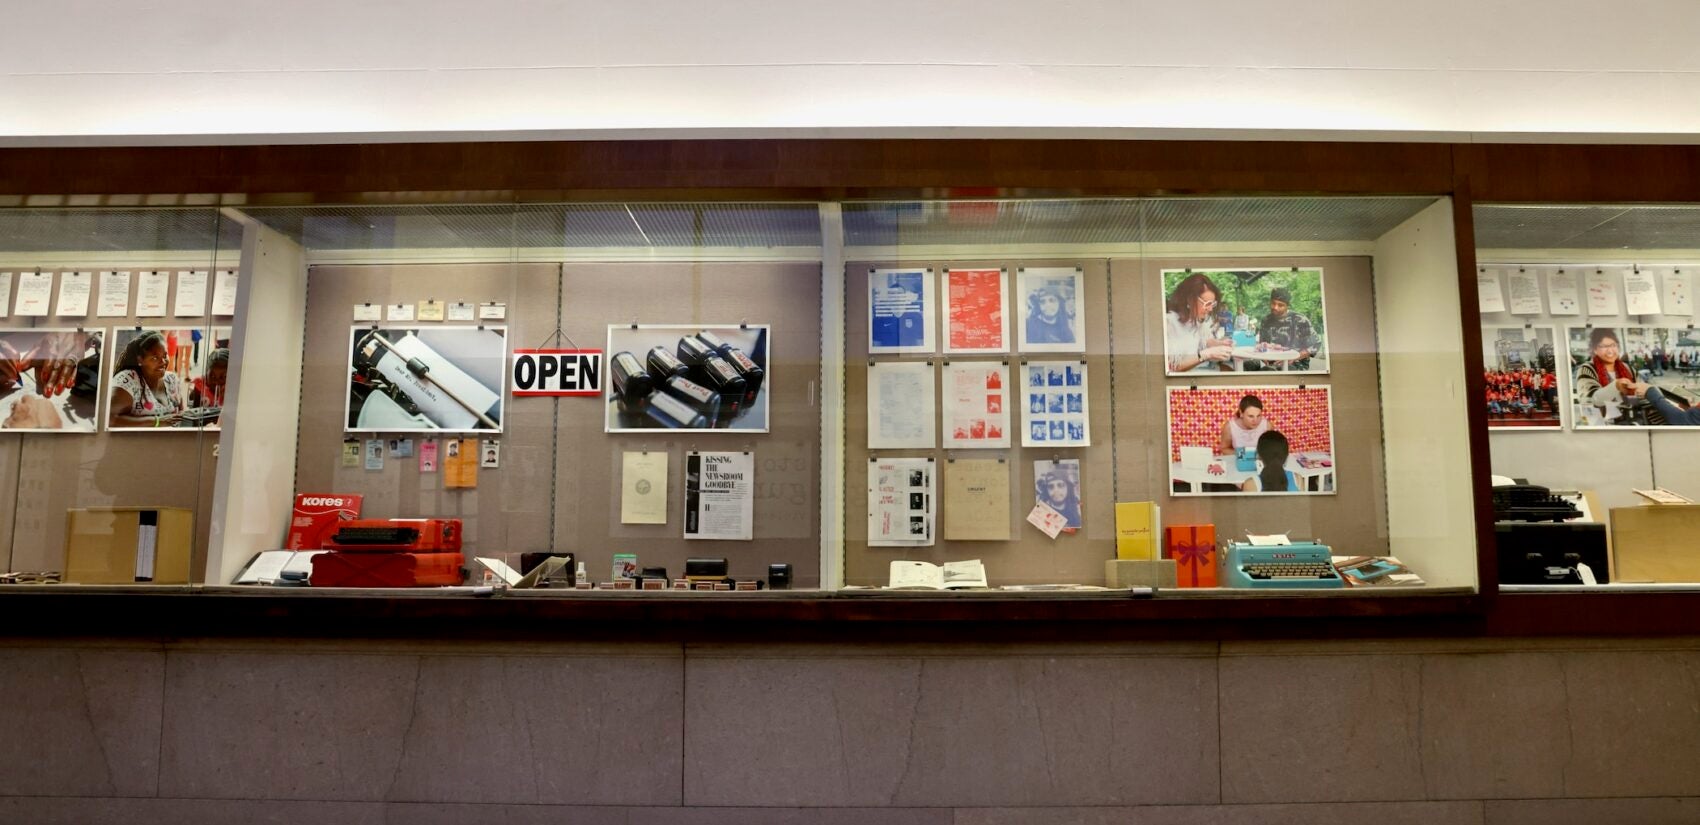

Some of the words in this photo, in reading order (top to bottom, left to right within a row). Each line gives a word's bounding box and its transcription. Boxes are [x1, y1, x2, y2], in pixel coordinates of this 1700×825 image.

[514, 354, 599, 390] OPEN
[705, 456, 732, 464] KISSING
[705, 464, 717, 472] THE
[705, 472, 744, 481] NEWSROOM
[704, 481, 735, 489] GOODBYE
